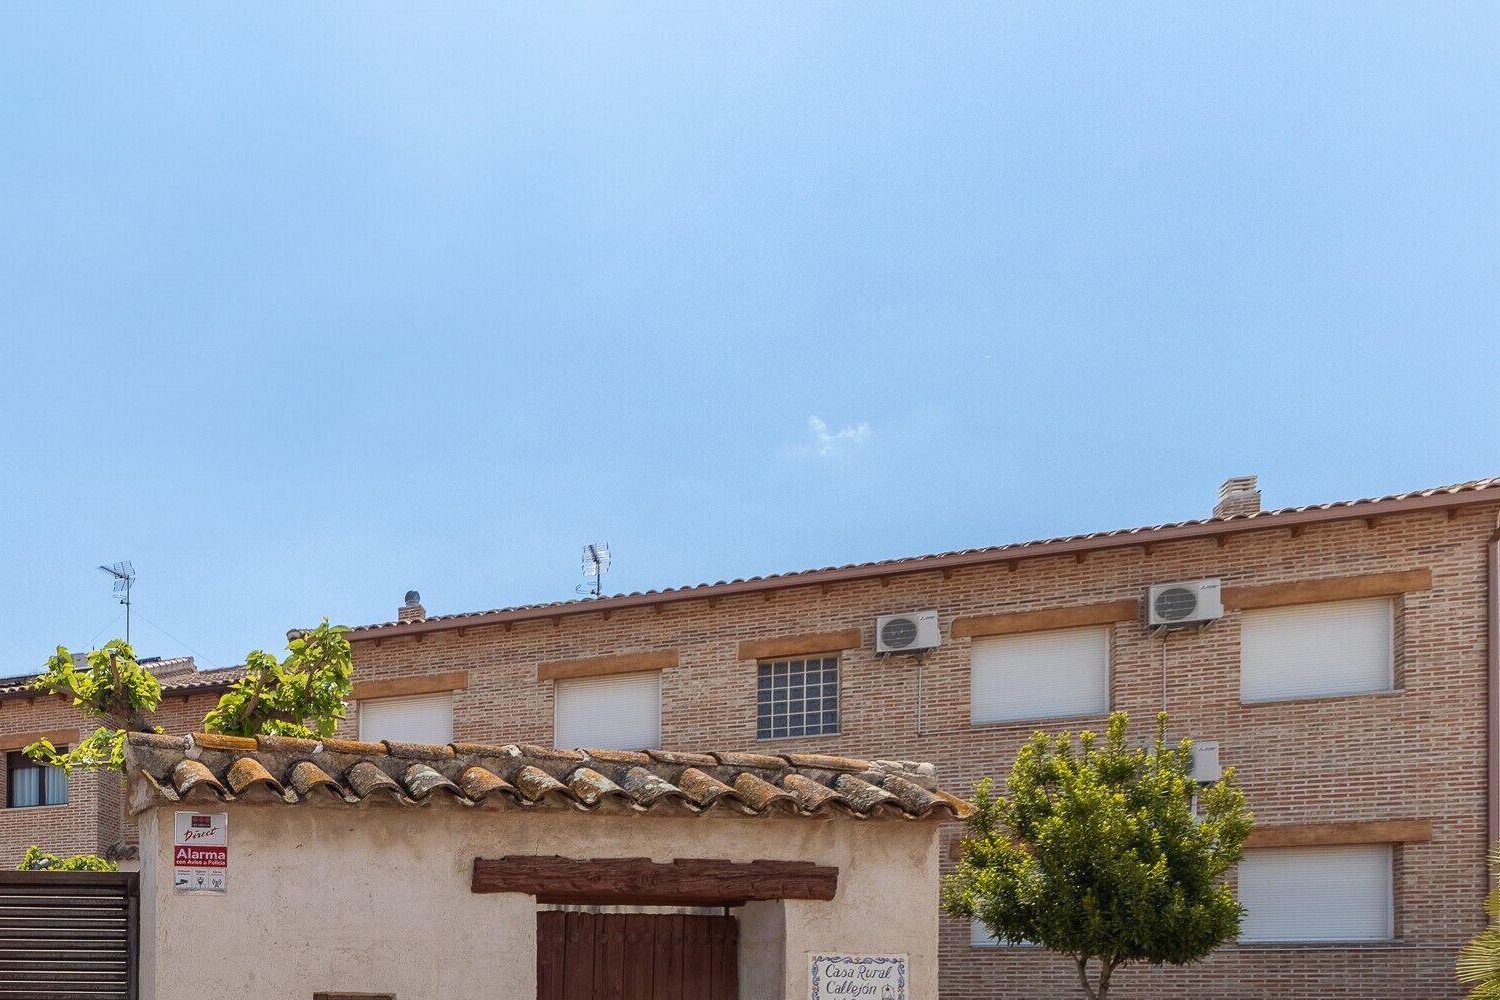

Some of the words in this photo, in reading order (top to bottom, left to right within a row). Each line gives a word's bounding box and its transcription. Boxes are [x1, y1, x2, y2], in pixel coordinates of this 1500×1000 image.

[184, 828, 219, 841] Direct
[177, 848, 226, 859] Alarma
[826, 964, 854, 978] Casa
[857, 965, 893, 981] Rural
[826, 980, 877, 997] Callejón
